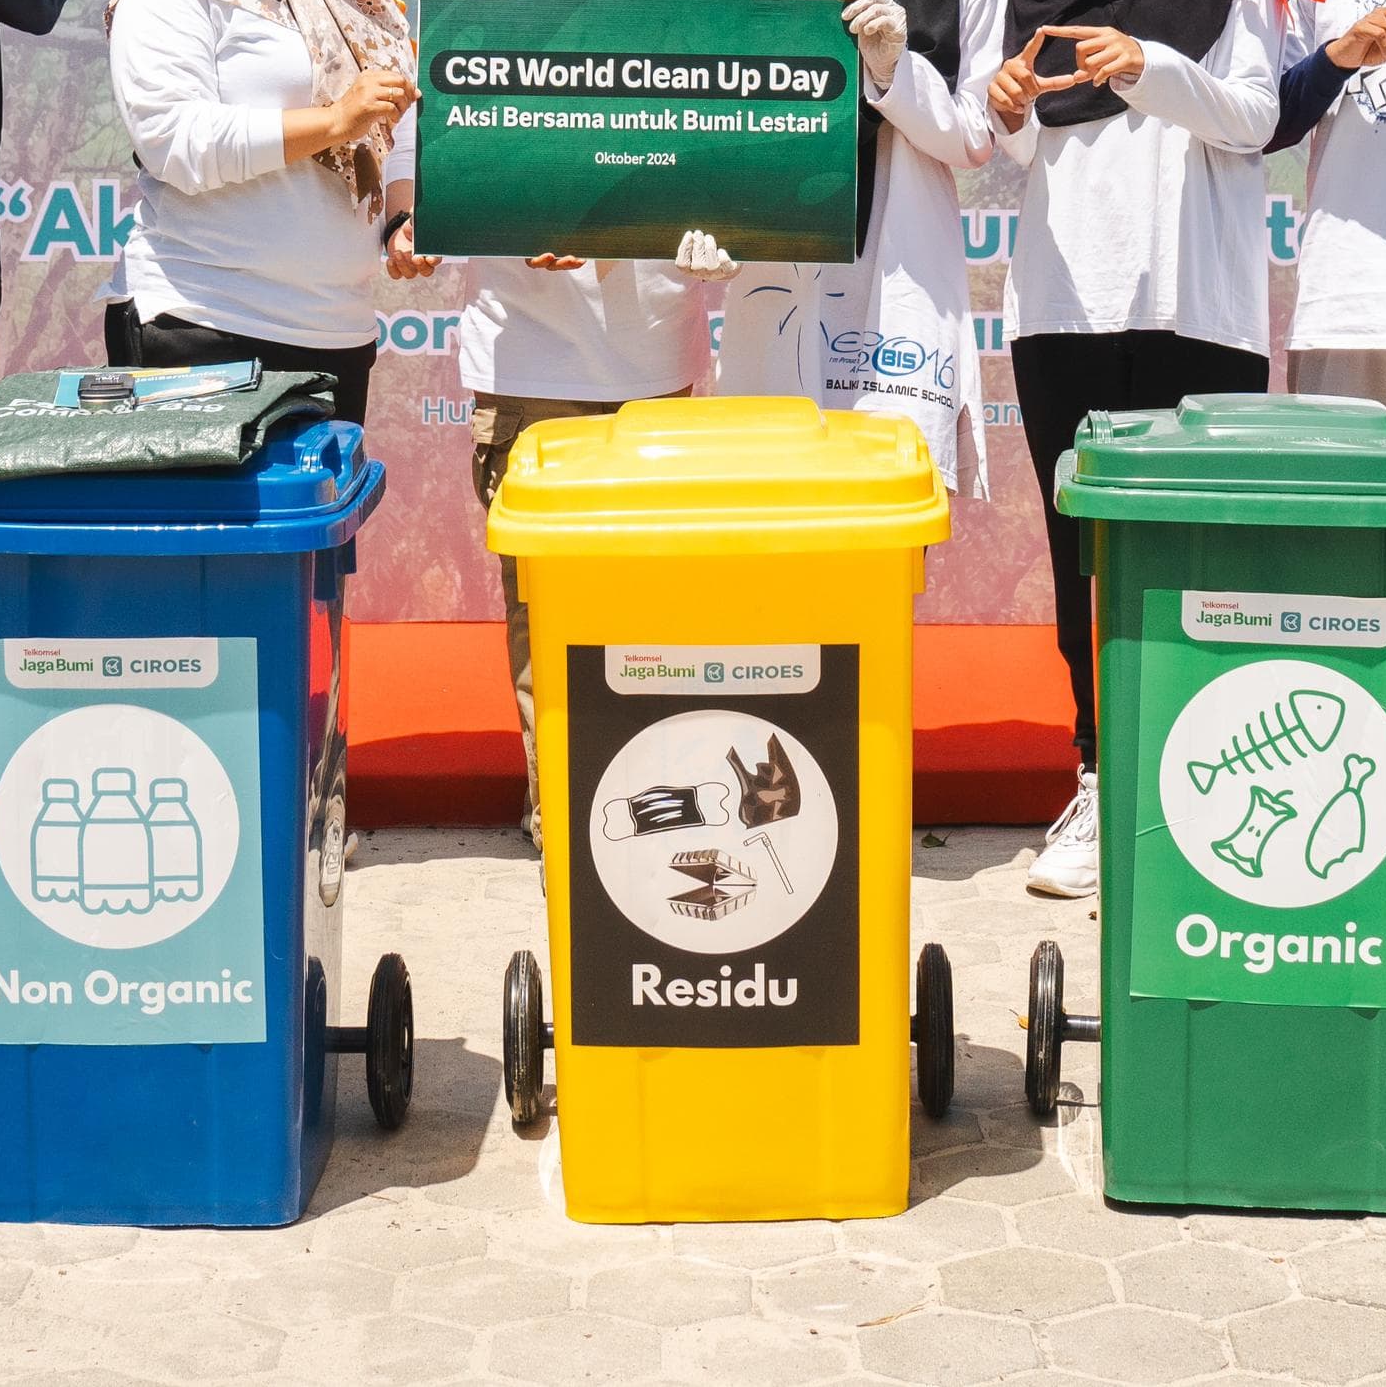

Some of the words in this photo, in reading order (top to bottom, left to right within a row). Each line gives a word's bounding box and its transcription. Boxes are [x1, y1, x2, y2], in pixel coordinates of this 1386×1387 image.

[445, 57, 510, 86] CSR
[516, 57, 614, 88] World
[621, 59, 709, 91] Clean
[717, 62, 761, 97] Up
[769, 63, 830, 98] Day
[446, 105, 498, 128] Aksi
[503, 106, 606, 130] Bersama
[610, 108, 678, 131] untuk
[683, 109, 742, 132] Bumi
[747, 110, 829, 134] Lestari
[594, 151, 645, 166] Oktober
[647, 152, 676, 166] 2024
[881, 348, 917, 369] BIS
[862, 380, 918, 397] ISLAMIC
[920, 389, 955, 410] SCHOOL
[1201, 601, 1240, 609] Telkomsel
[1195, 610, 1232, 627] Jaga
[1234, 611, 1273, 628] Bumi
[1308, 616, 1381, 633] CIROES
[19, 658, 54, 675] Jaga
[56, 658, 93, 673] Bumi
[130, 659, 202, 673] CIROES
[624, 654, 662, 662] Telkomsel
[620, 663, 654, 680] Jaga
[657, 663, 696, 679] Bumi
[732, 664, 804, 680] CIROES
[1175, 913, 1382, 974] Organic
[85, 969, 253, 1014] Organic
[631, 963, 799, 1007] Residu
